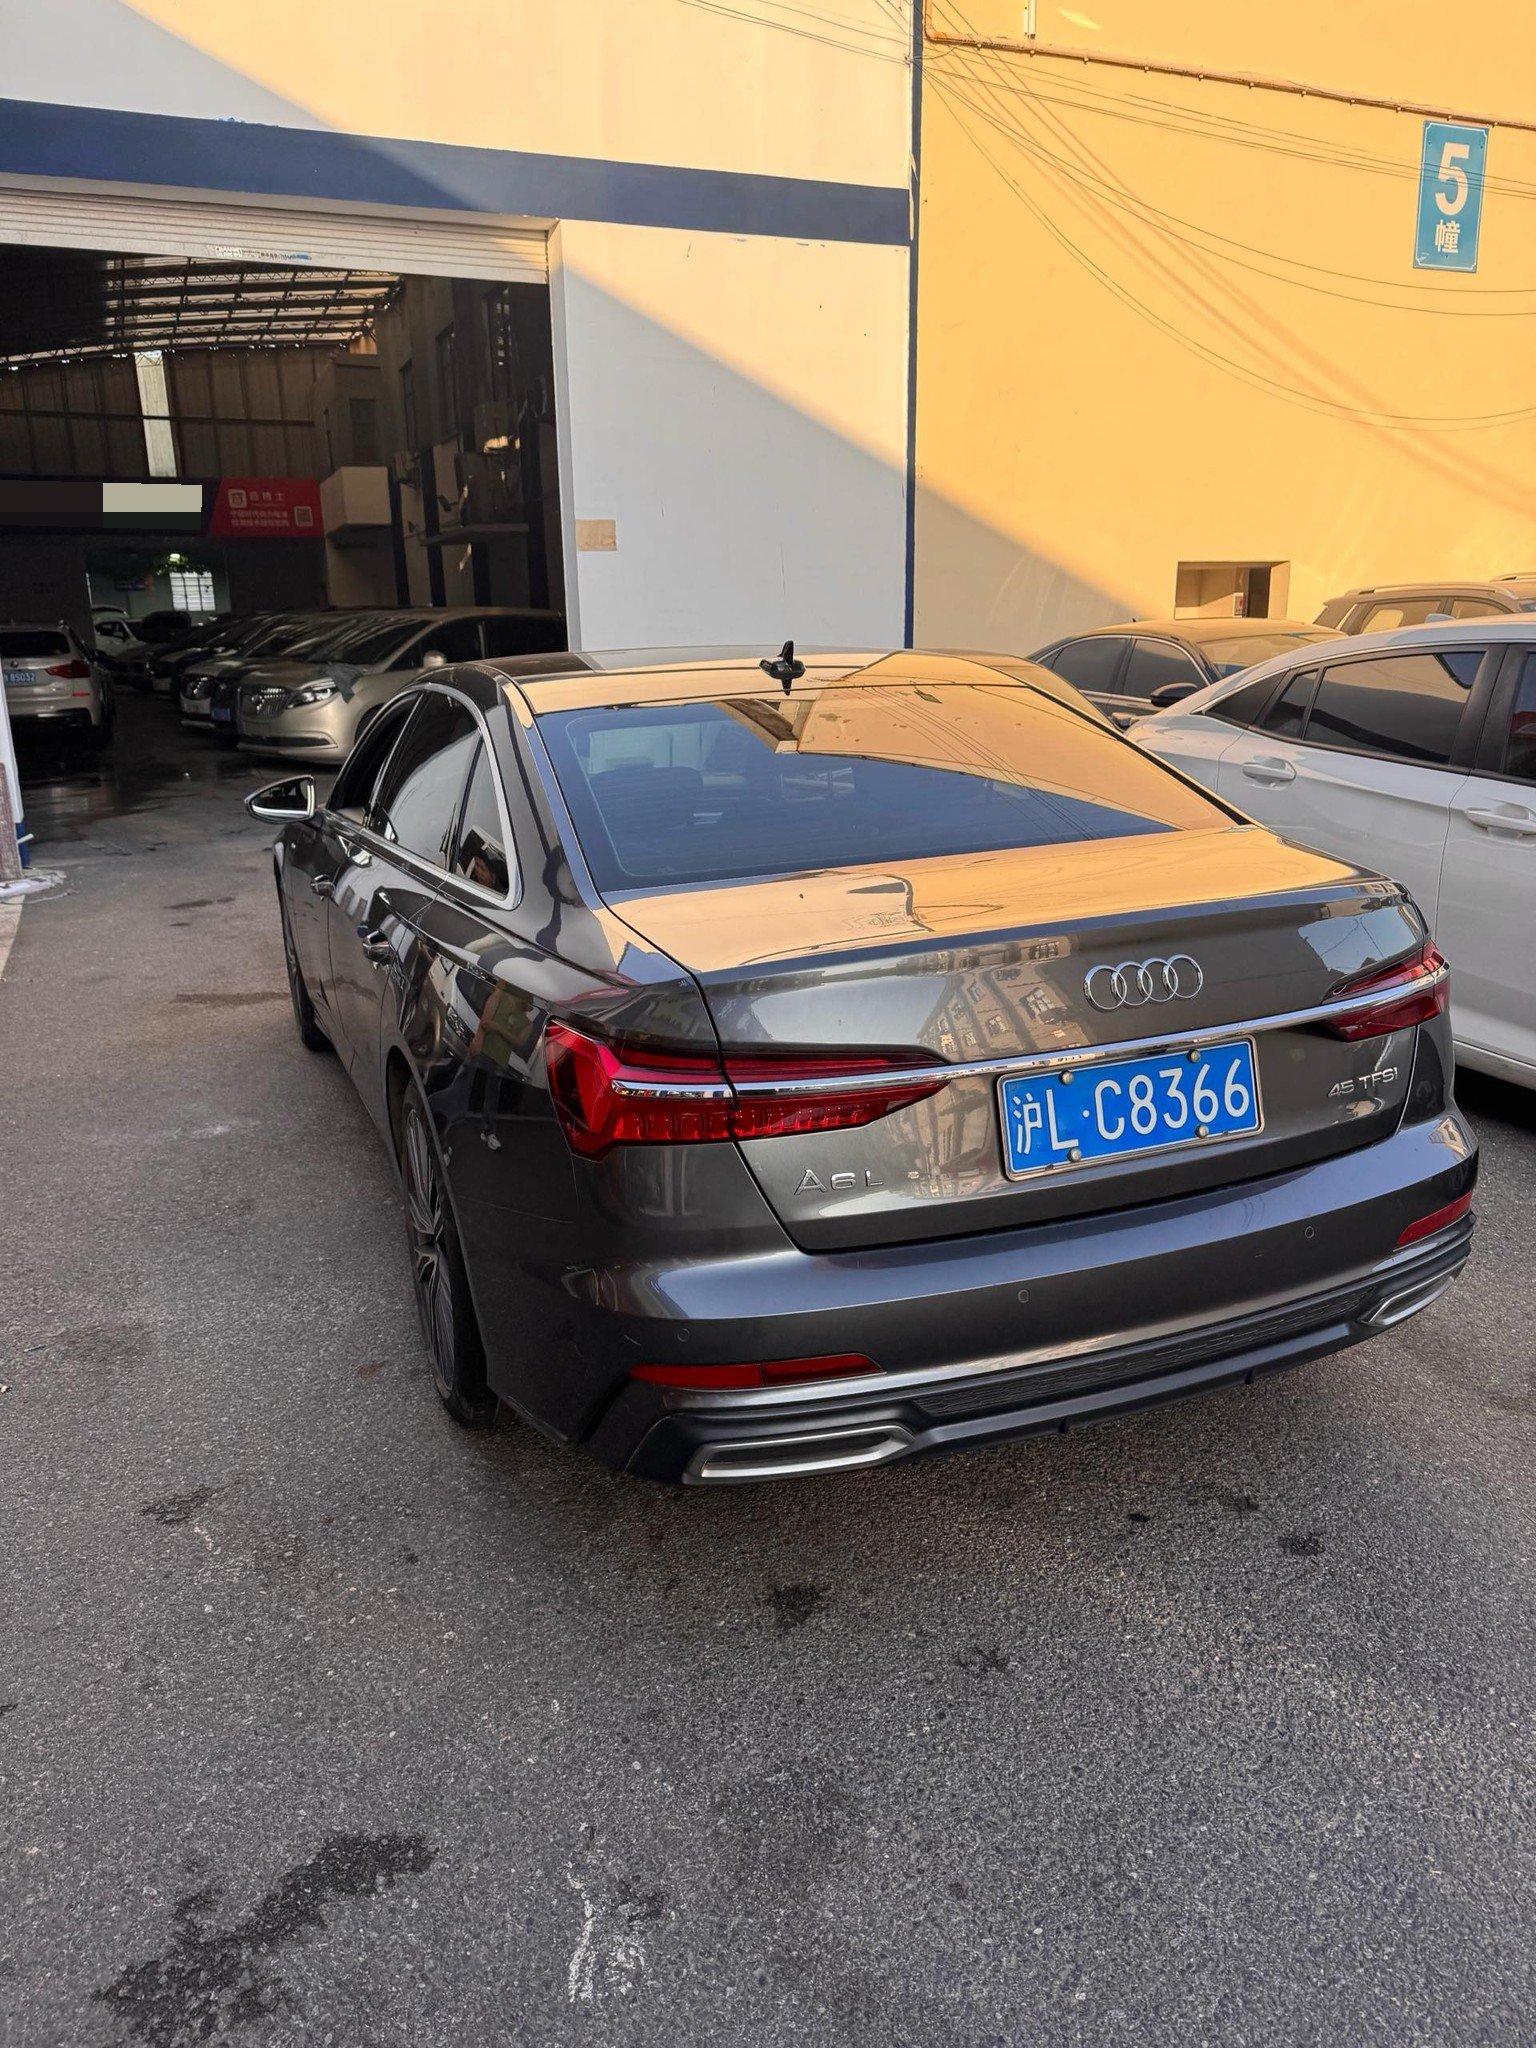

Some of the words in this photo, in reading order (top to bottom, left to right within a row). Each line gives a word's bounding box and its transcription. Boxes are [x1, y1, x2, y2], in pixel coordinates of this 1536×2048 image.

[1435, 142, 1470, 216] 5
[1327, 1080, 1355, 1098] 45
[1358, 1066, 1398, 1090] TFSI
